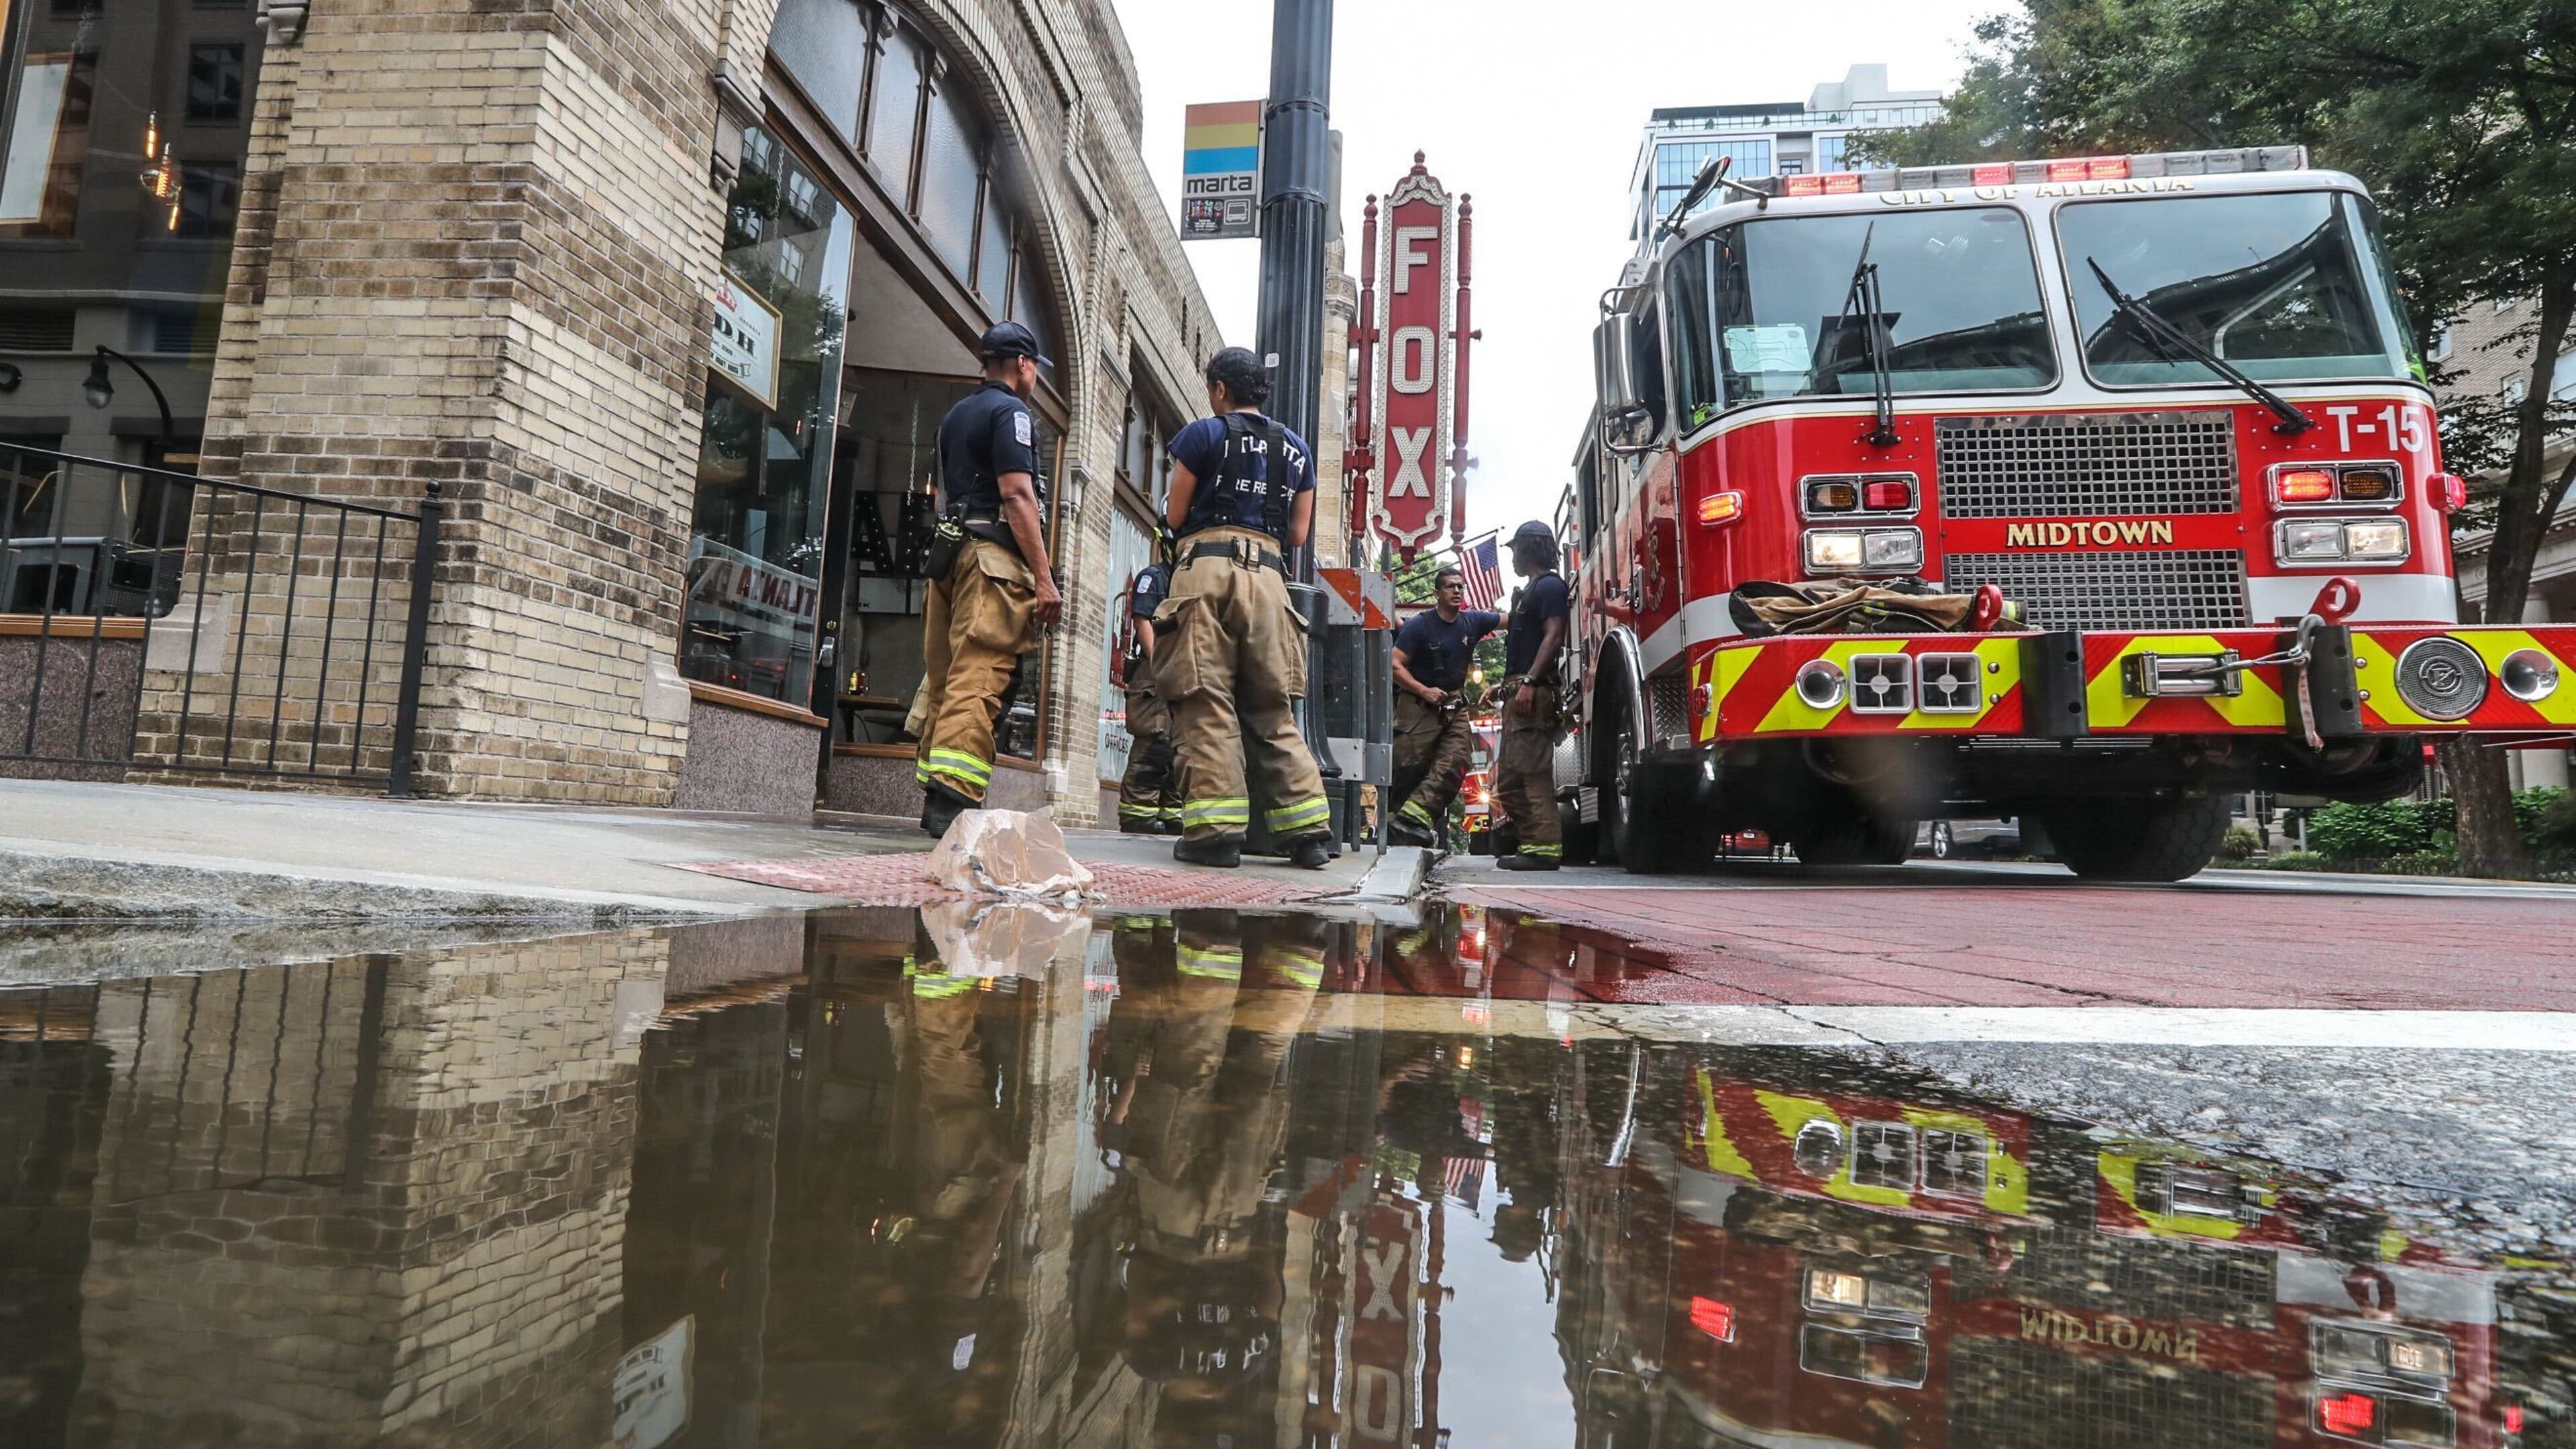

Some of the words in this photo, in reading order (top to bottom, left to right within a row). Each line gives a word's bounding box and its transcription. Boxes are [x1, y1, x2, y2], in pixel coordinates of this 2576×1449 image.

[1187, 174, 1252, 194] marta
[1879, 190, 1955, 205] CITY
[1974, 185, 2019, 201] OF
[2035, 178, 2195, 199] ATLANTA
[1387, 226, 1438, 498] FOX
[2326, 405, 2424, 453] T-15
[2006, 520, 2174, 547] MIDTOWN
